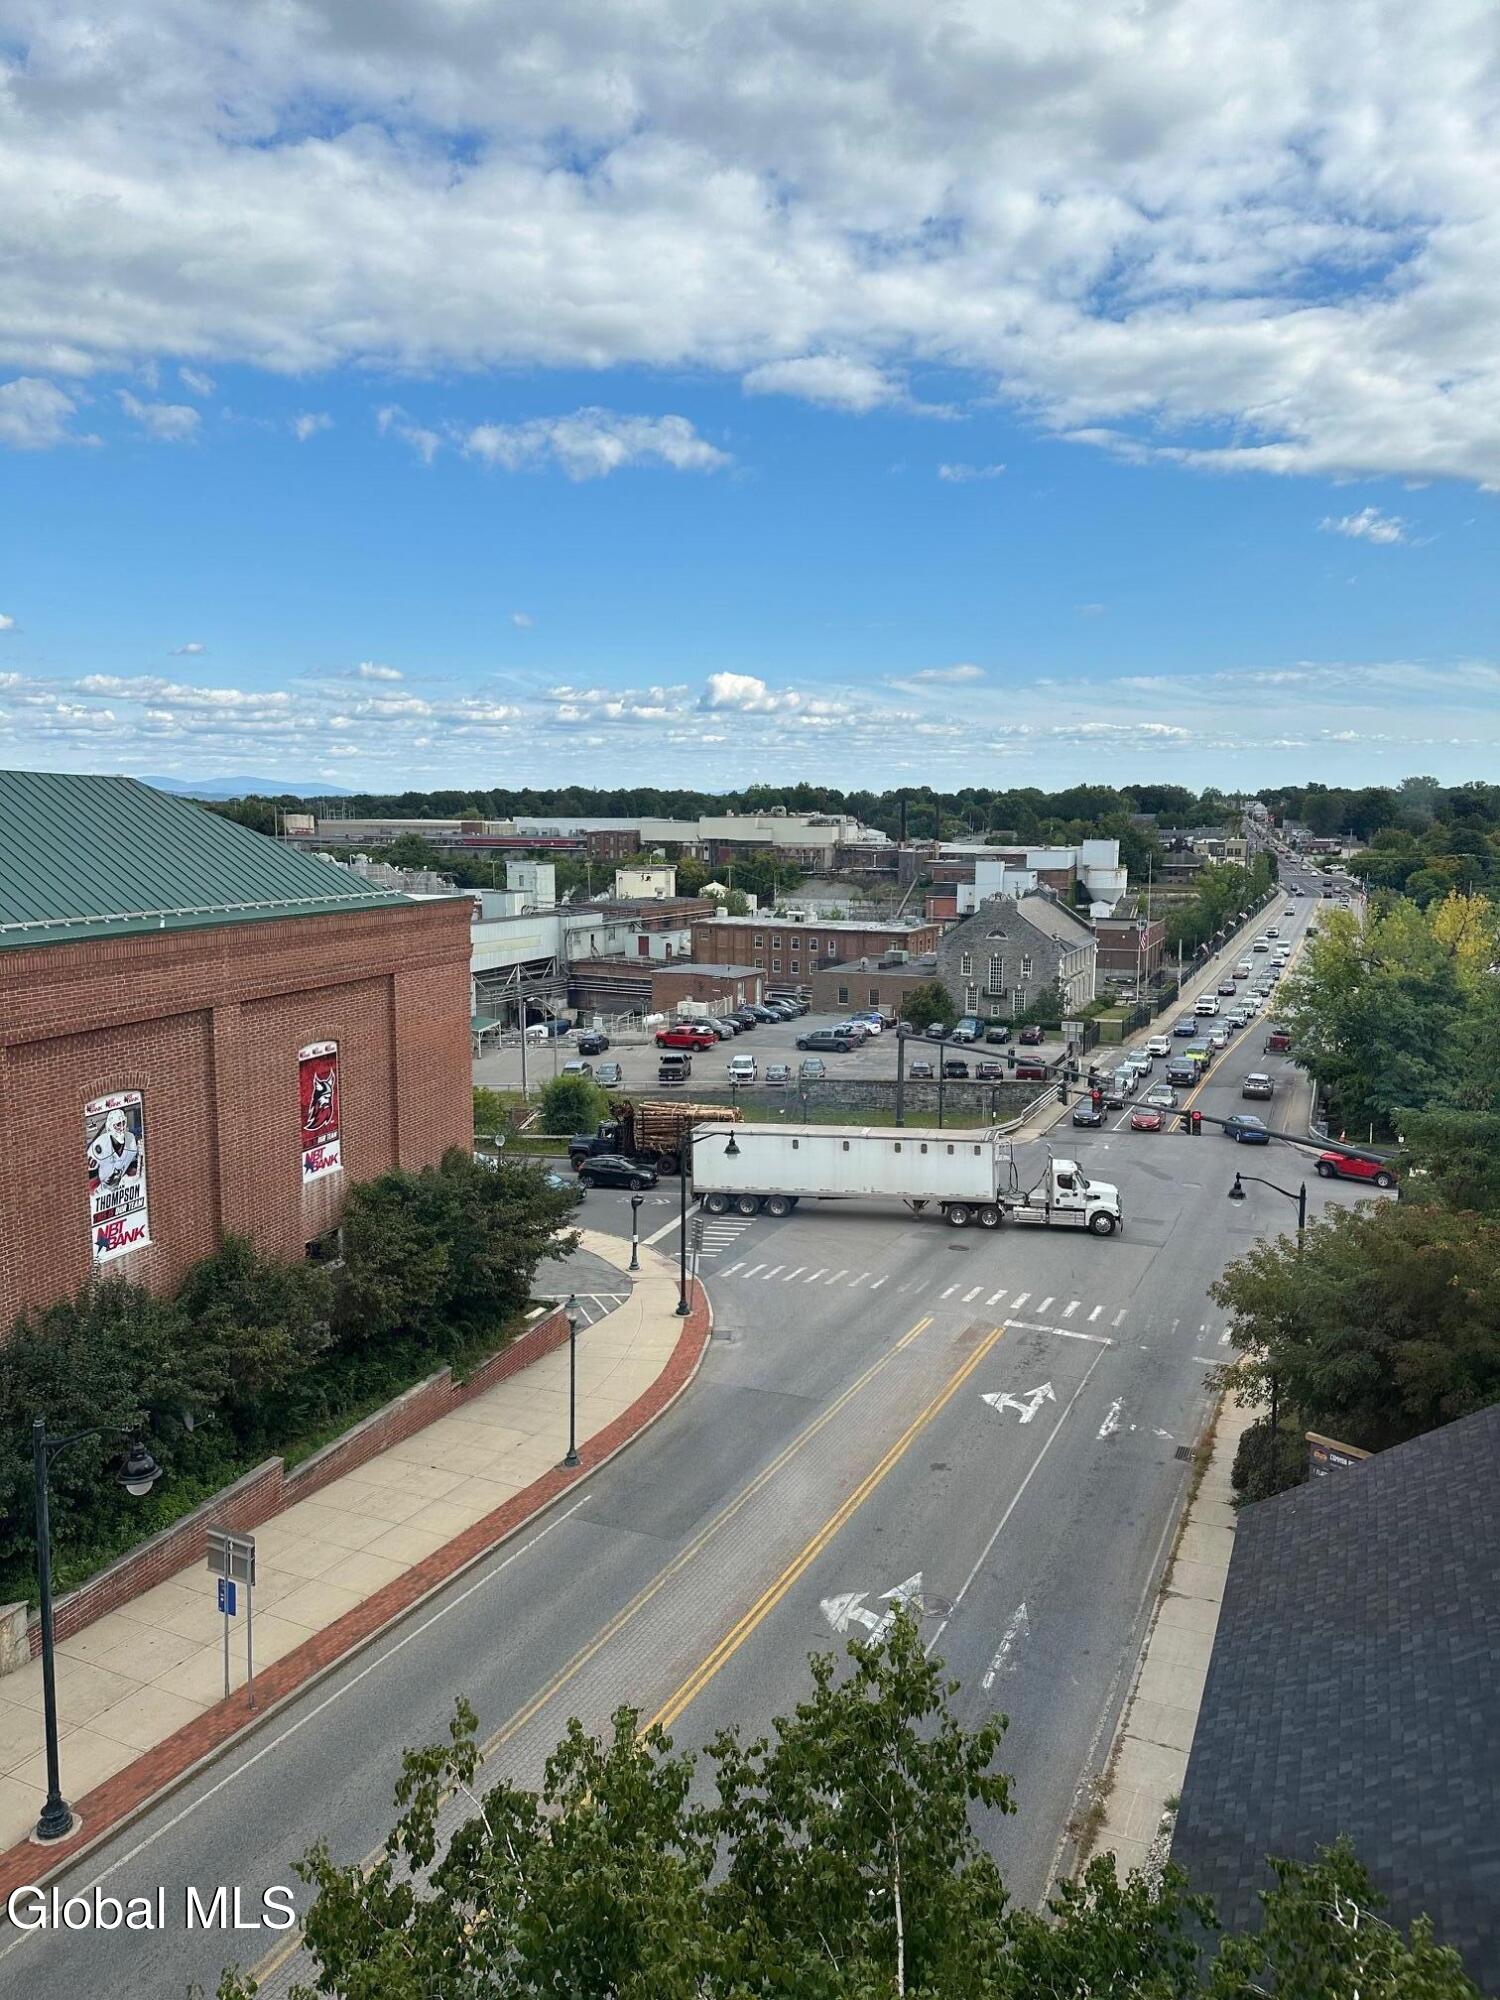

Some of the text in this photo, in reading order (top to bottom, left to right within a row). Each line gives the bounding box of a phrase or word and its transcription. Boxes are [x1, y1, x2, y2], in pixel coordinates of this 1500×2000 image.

[306, 1147, 326, 1162] NBT
[311, 1153, 338, 1173] BANK
[96, 1184, 140, 1212] THOMPSON
[97, 1218, 127, 1240] NBT
[106, 1224, 145, 1252] BANK
